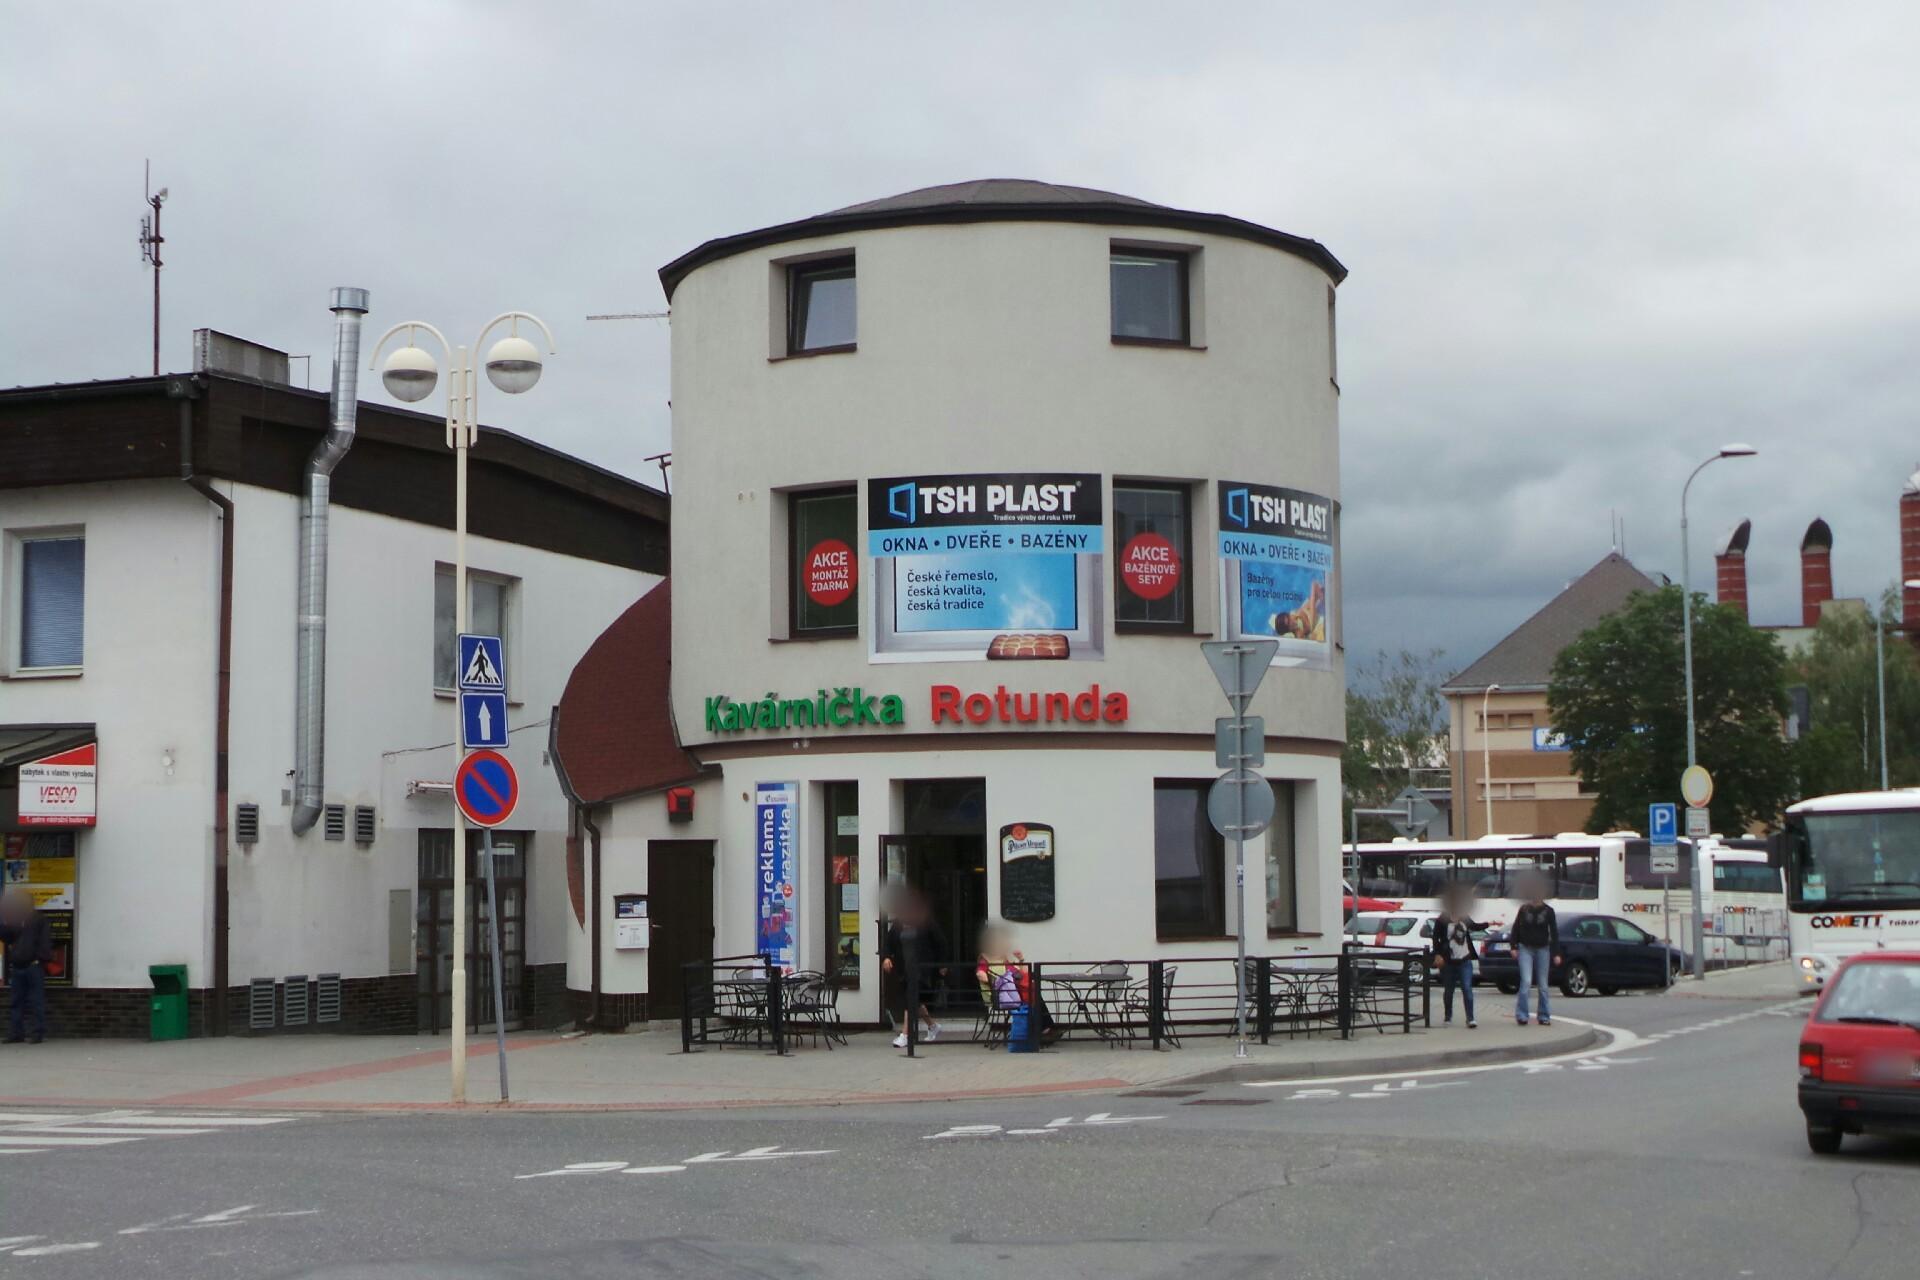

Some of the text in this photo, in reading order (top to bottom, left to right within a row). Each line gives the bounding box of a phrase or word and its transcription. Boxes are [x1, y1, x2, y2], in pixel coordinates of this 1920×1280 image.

[919, 484, 1076, 514] TSH PLAST
[1250, 495, 1328, 532] TSH PLAST
[882, 530, 1088, 552] OKNA DVEŘE BAZÉNY
[1131, 546, 1169, 561] AKCE
[1224, 540, 1257, 556] OKNA
[1268, 542, 1300, 561] DVEŘE
[812, 551, 848, 568] AKCE
[812, 566, 848, 581] MONTÁŽ
[1124, 561, 1176, 575] BAZÉNOVÉ
[907, 569, 998, 583] České řemeslo,
[1138, 574, 1163, 584] SETY
[1247, 572, 1274, 588] Bazény
[812, 580, 848, 592] ZDARMA
[907, 584, 986, 596] česká kvalita,
[1248, 589, 1260, 600] pro
[907, 598, 984, 611] česká tradice
[705, 684, 1130, 732] Kavárnička Rotunda
[40, 786, 77, 803] VESCO
[1655, 808, 1671, 833] P
[760, 808, 774, 893] reklama
[778, 808, 792, 880] razítka
[1622, 903, 1661, 913] COMETT
[1811, 914, 1884, 928] COMETT
